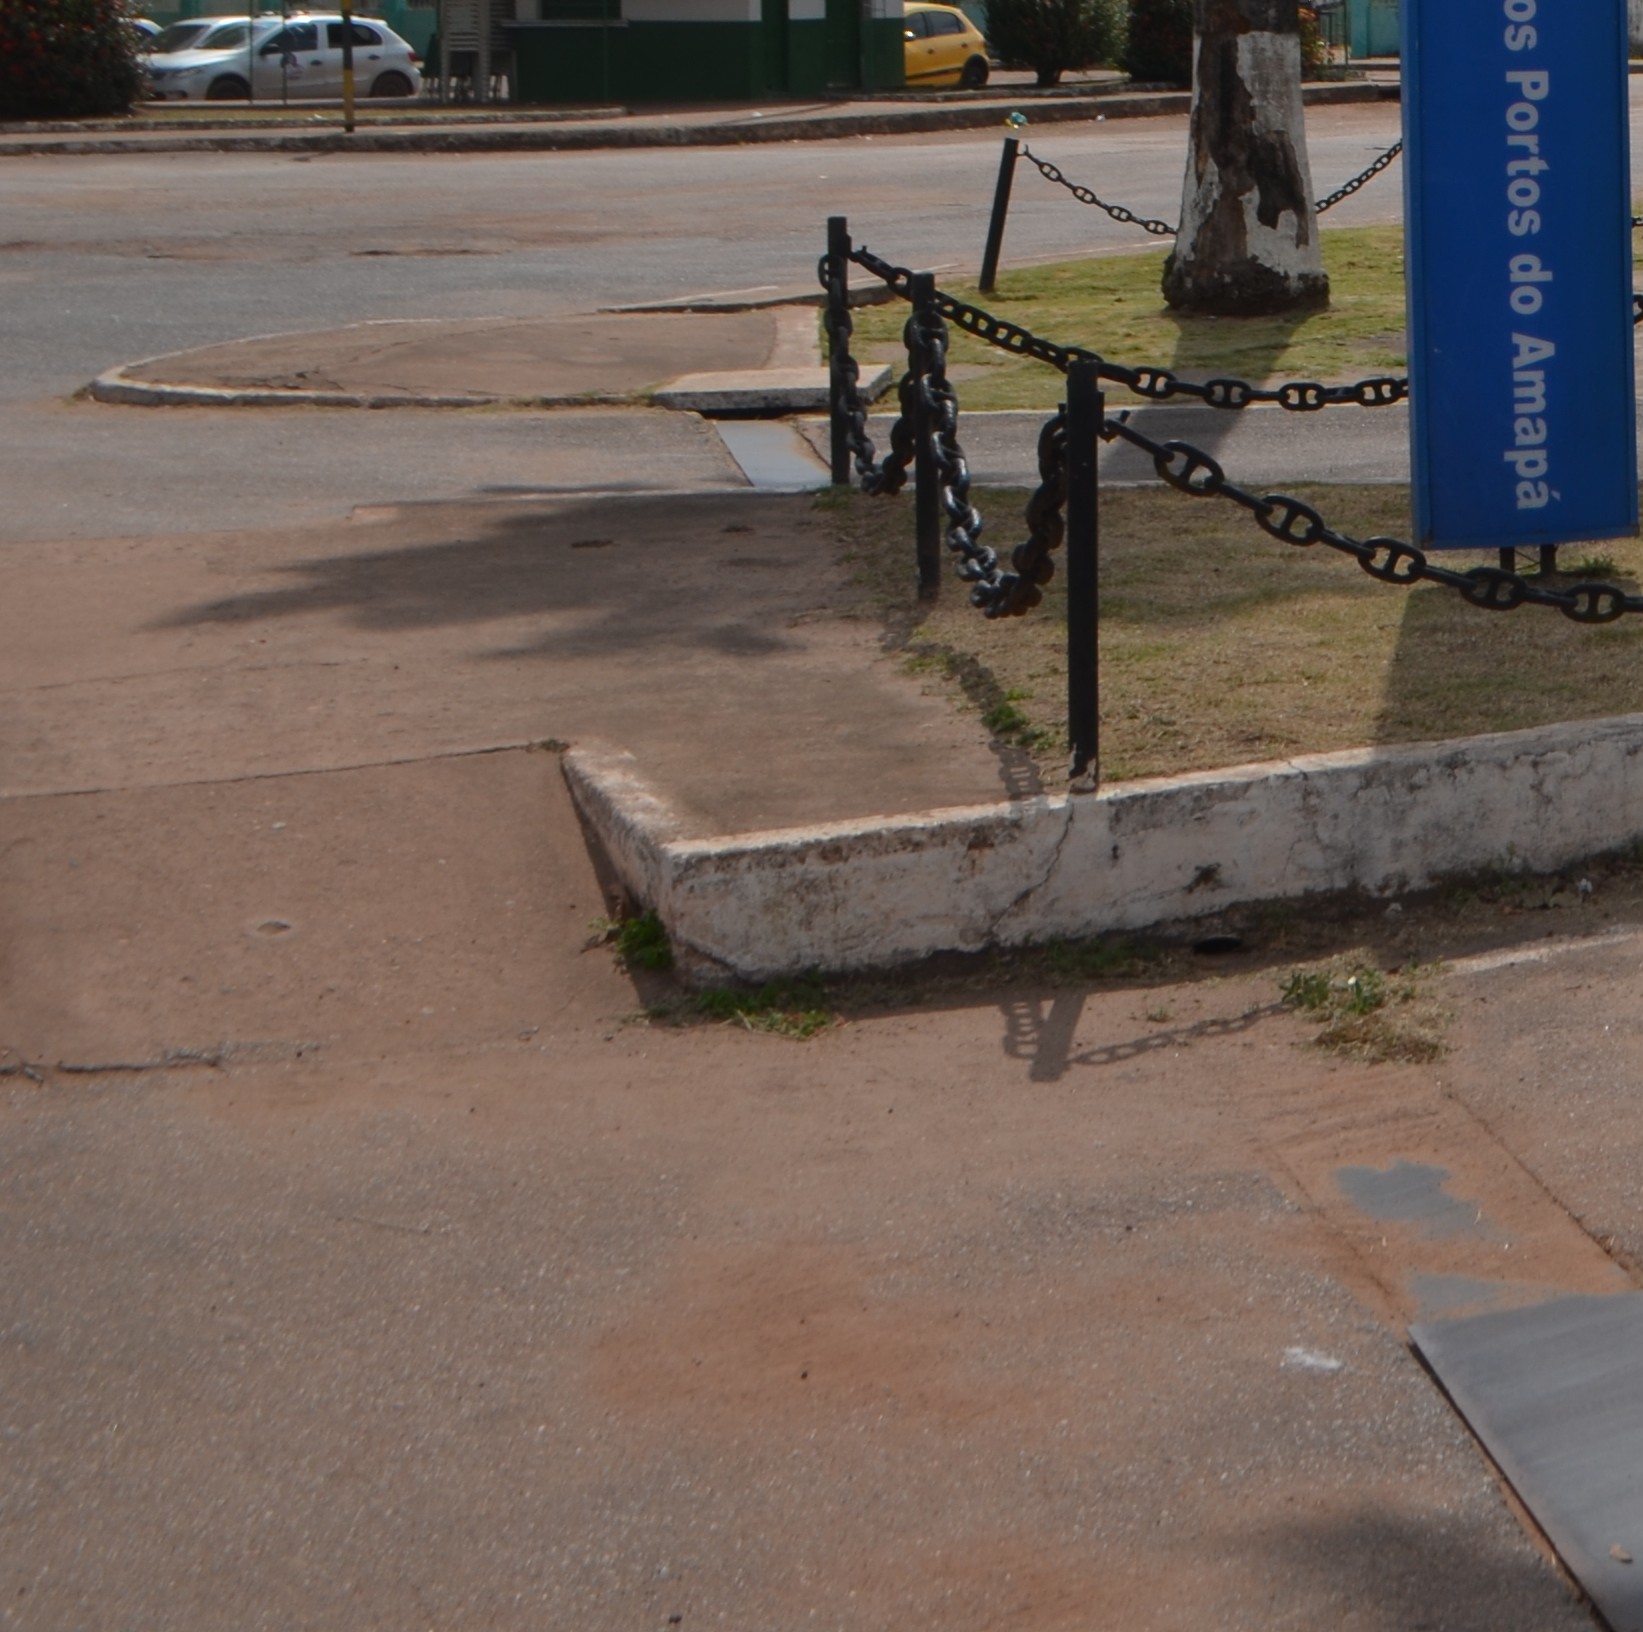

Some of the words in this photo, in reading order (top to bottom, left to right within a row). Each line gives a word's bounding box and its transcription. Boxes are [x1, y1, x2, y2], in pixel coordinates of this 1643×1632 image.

[1506, 69, 1550, 237] Portos
[1508, 253, 1553, 315] do
[1505, 332, 1562, 508] Amapá
